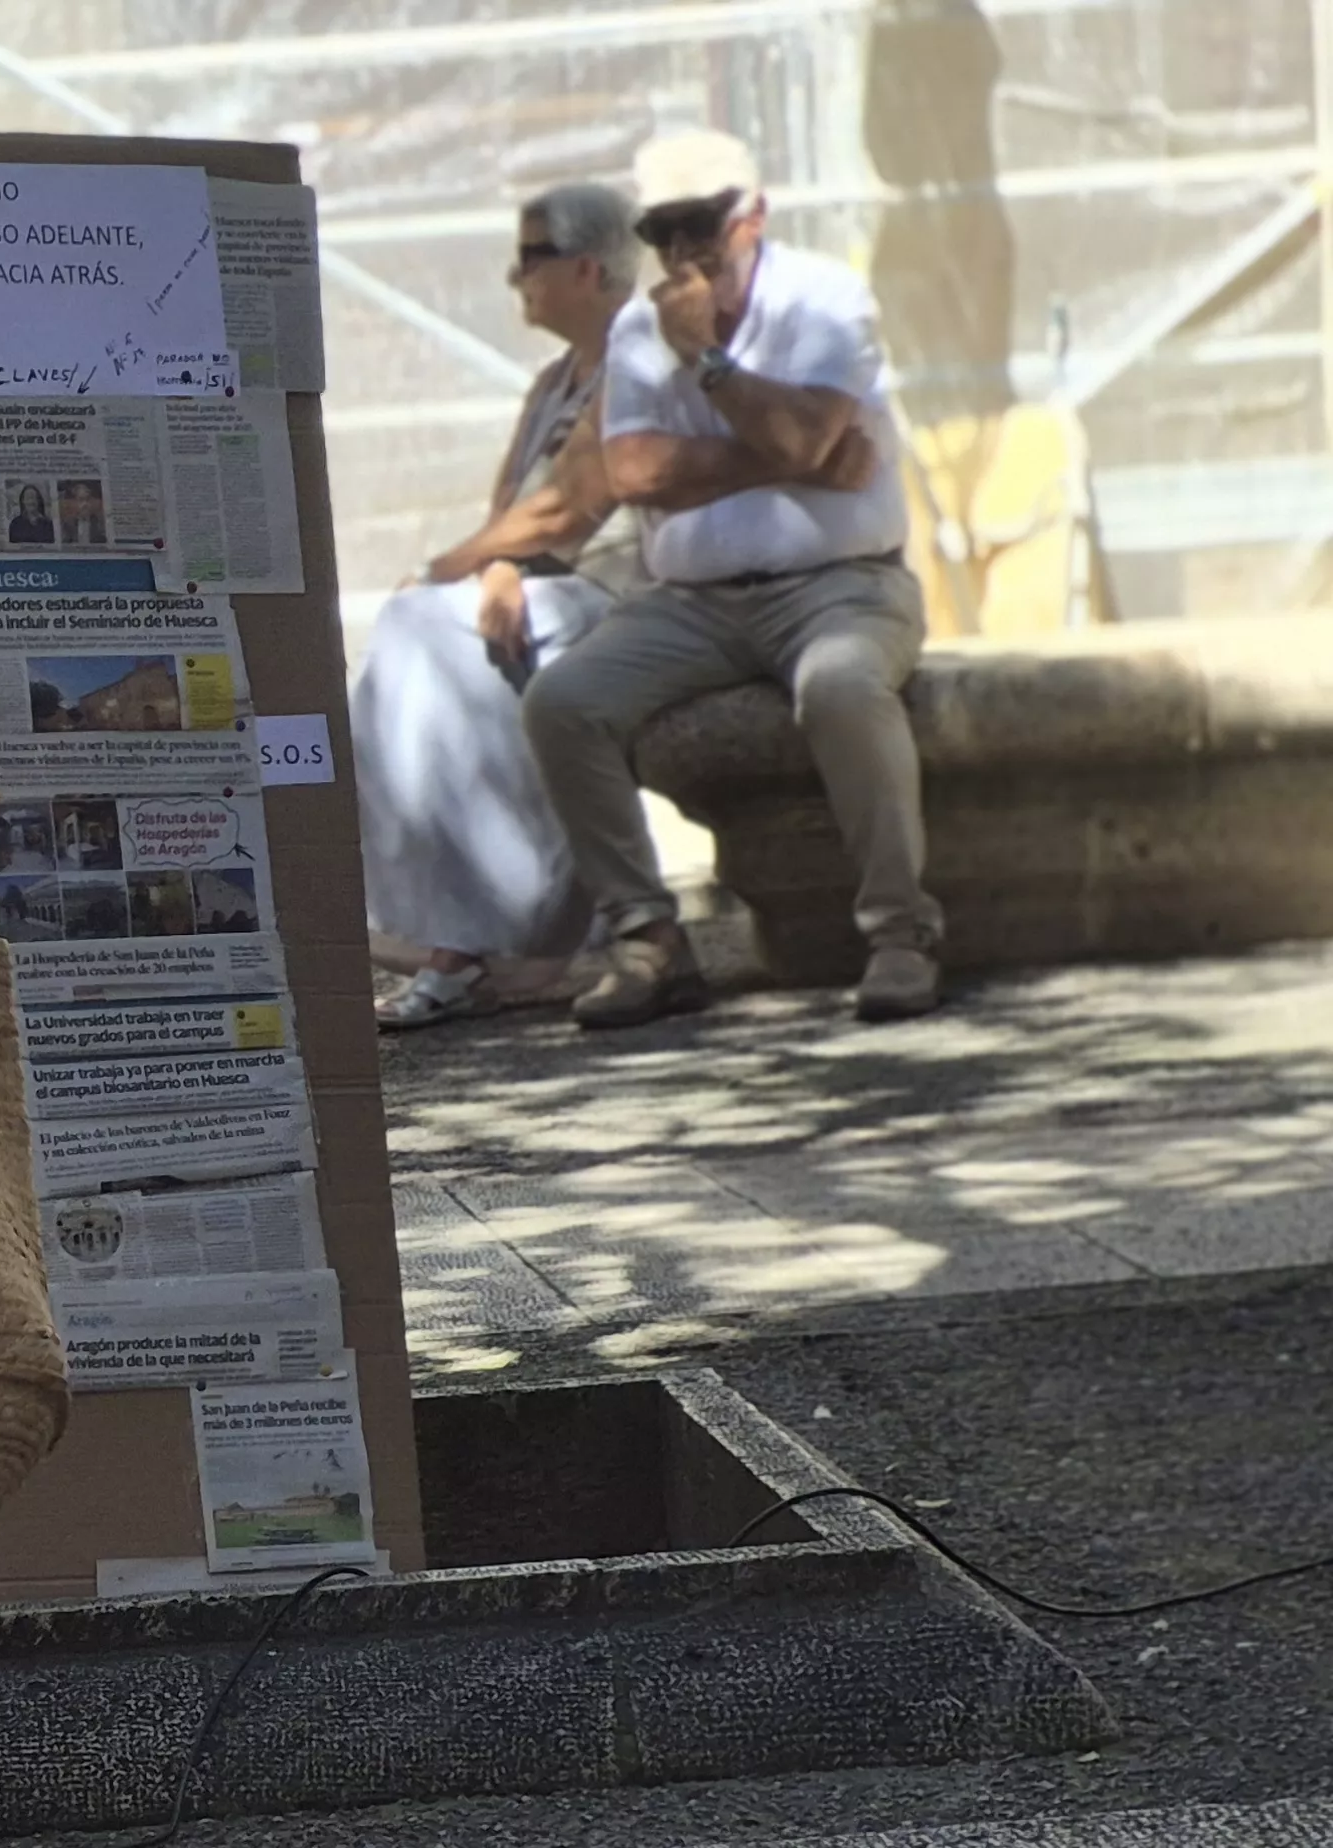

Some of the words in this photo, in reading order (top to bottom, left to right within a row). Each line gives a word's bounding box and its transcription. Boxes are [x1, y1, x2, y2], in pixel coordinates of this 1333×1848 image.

[26, 224, 144, 250] ADELANTE,
[50, 260, 124, 286] ATRÁS.
[5, 418, 22, 429] PP
[24, 418, 39, 430] de
[41, 419, 86, 430] Huesca
[46, 596, 113, 611] estudiará
[116, 597, 129, 610] la
[131, 598, 204, 614] propuesta
[6, 615, 50, 630] incluir
[53, 615, 67, 629] el
[68, 614, 141, 629] Seminario
[144, 615, 162, 628] de
[165, 615, 218, 628] Huesca
[260, 743, 324, 765] S.O.S
[190, 811, 206, 823] de
[209, 810, 227, 823] las
[138, 844, 155, 856] de
[158, 842, 207, 857] Aragón
[25, 1018, 42, 1030] La
[43, 1014, 123, 1029] Universidad
[125, 1011, 171, 1027] trabaja
[174, 1012, 190, 1023] en
[193, 1009, 224, 1021] traer
[27, 1033, 77, 1046] nuevos
[78, 1029, 124, 1047] grados
[126, 1029, 157, 1043] para
[159, 1026, 170, 1039] el
[172, 1025, 224, 1040] campus
[33, 1069, 75, 1083] Unizar
[78, 1064, 124, 1083] trabaja
[126, 1065, 142, 1079] ya
[144, 1063, 174, 1079] para
[176, 1060, 214, 1075] poner
[217, 1059, 234, 1069] en
[235, 1053, 285, 1068] marcha
[36, 1086, 48, 1099] el
[49, 1084, 102, 1099] campus
[104, 1077, 182, 1095] biosanitario
[183, 1077, 200, 1088] en
[202, 1073, 250, 1087] Huesca
[67, 1336, 115, 1354] Aragón
[117, 1337, 173, 1353] produce
[175, 1337, 187, 1348] la
[189, 1333, 227, 1347] mitad
[230, 1333, 247, 1346] de
[249, 1332, 261, 1345] la
[67, 1354, 124, 1369] vivienda
[127, 1354, 143, 1368] de
[145, 1353, 156, 1366] la
[159, 1354, 184, 1370] que
[188, 1349, 255, 1365] necesitará
[201, 1404, 223, 1415] San
[224, 1402, 251, 1417] Juan
[251, 1402, 267, 1413] de
[268, 1401, 279, 1412] la
[280, 1399, 309, 1412] Peña
[310, 1399, 347, 1411] recibe
[203, 1419, 227, 1430] más
[228, 1418, 244, 1430] de
[245, 1418, 253, 1429] 3
[254, 1416, 303, 1428] millones
[303, 1414, 319, 1425] de
[320, 1414, 354, 1424] euros
